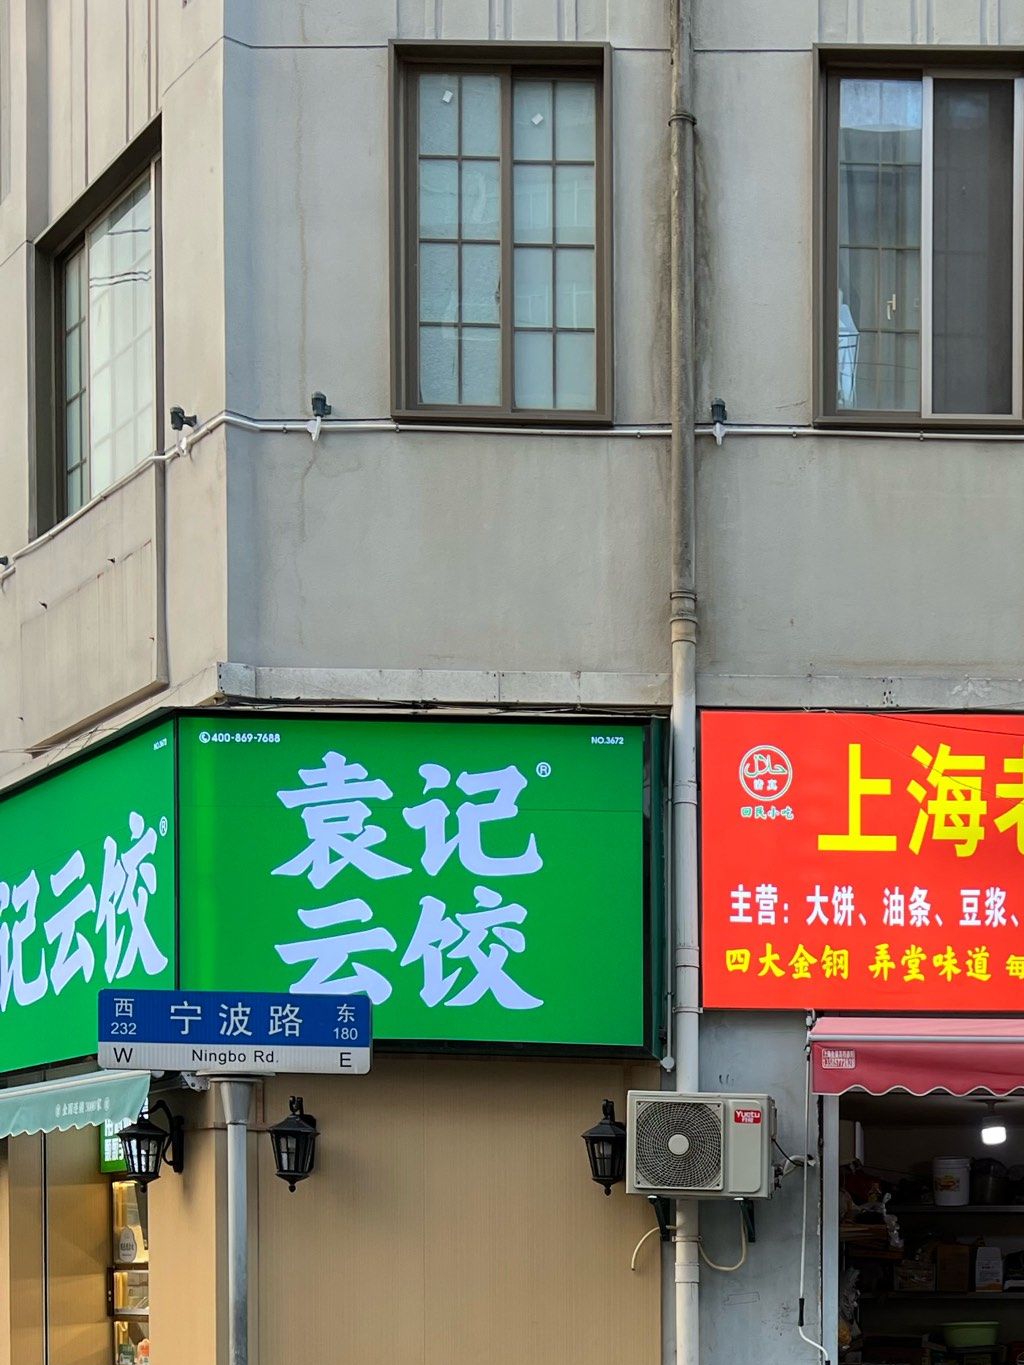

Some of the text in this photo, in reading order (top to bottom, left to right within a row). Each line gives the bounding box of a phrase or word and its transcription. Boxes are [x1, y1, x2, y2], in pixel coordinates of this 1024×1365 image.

[211, 733, 281, 744] 400-869-7688
[590, 736, 625, 746] NO.3672
[271, 751, 544, 890] 袁记
[740, 805, 795, 820] 回民小吃
[274, 885, 545, 1011] 云饺
[725, 943, 850, 980] 四大金钢
[868, 943, 993, 982] 弄堂味道
[113, 998, 134, 1019] 西
[336, 1003, 357, 1024] 东
[169, 1000, 304, 1038] 宁波路
[110, 1022, 137, 1036] 232
[333, 1027, 359, 1041] 180
[112, 1047, 134, 1064] W
[191, 1050, 280, 1066] Ningbo Rd.
[339, 1052, 353, 1069] E
